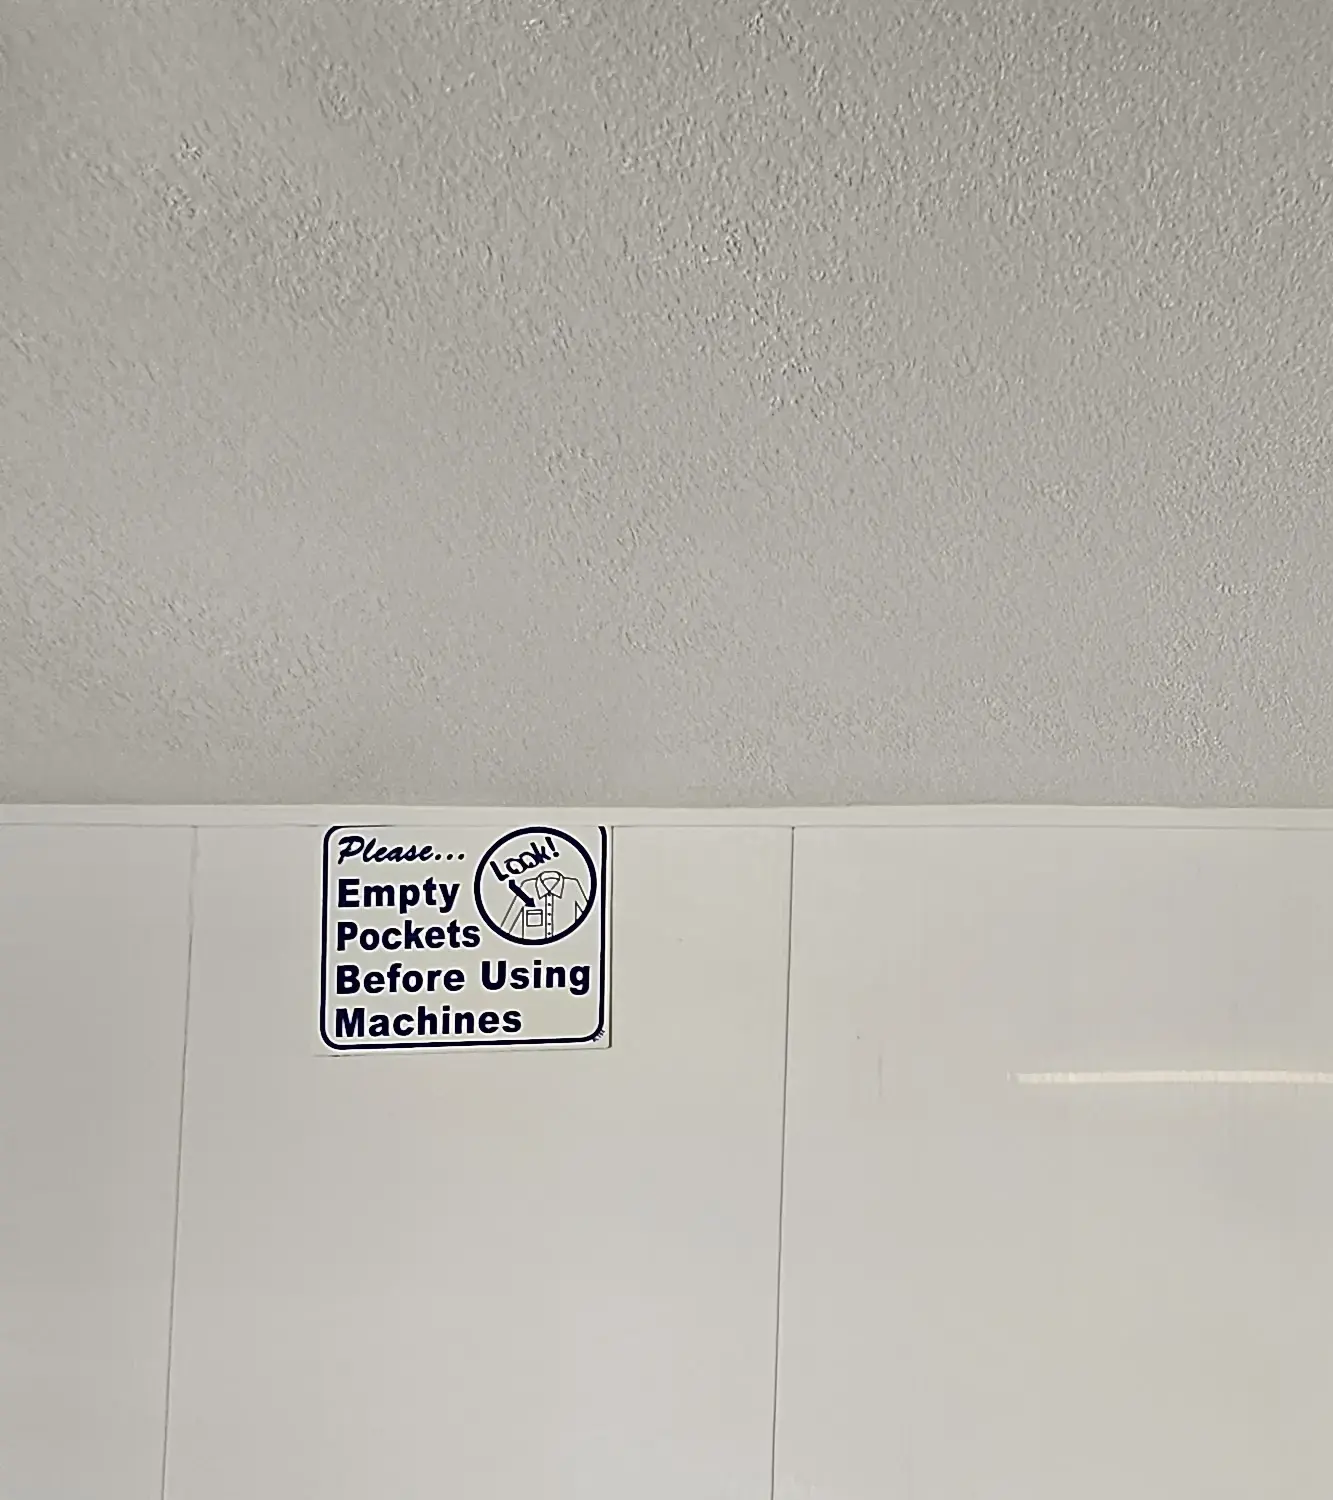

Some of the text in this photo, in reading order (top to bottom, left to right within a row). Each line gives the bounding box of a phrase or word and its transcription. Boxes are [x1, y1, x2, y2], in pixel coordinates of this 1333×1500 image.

[338, 836, 465, 864] Please...
[338, 877, 460, 914] Empty
[337, 920, 480, 951] Pockets
[336, 960, 590, 995] Before Using
[335, 1005, 522, 1038] Machines
